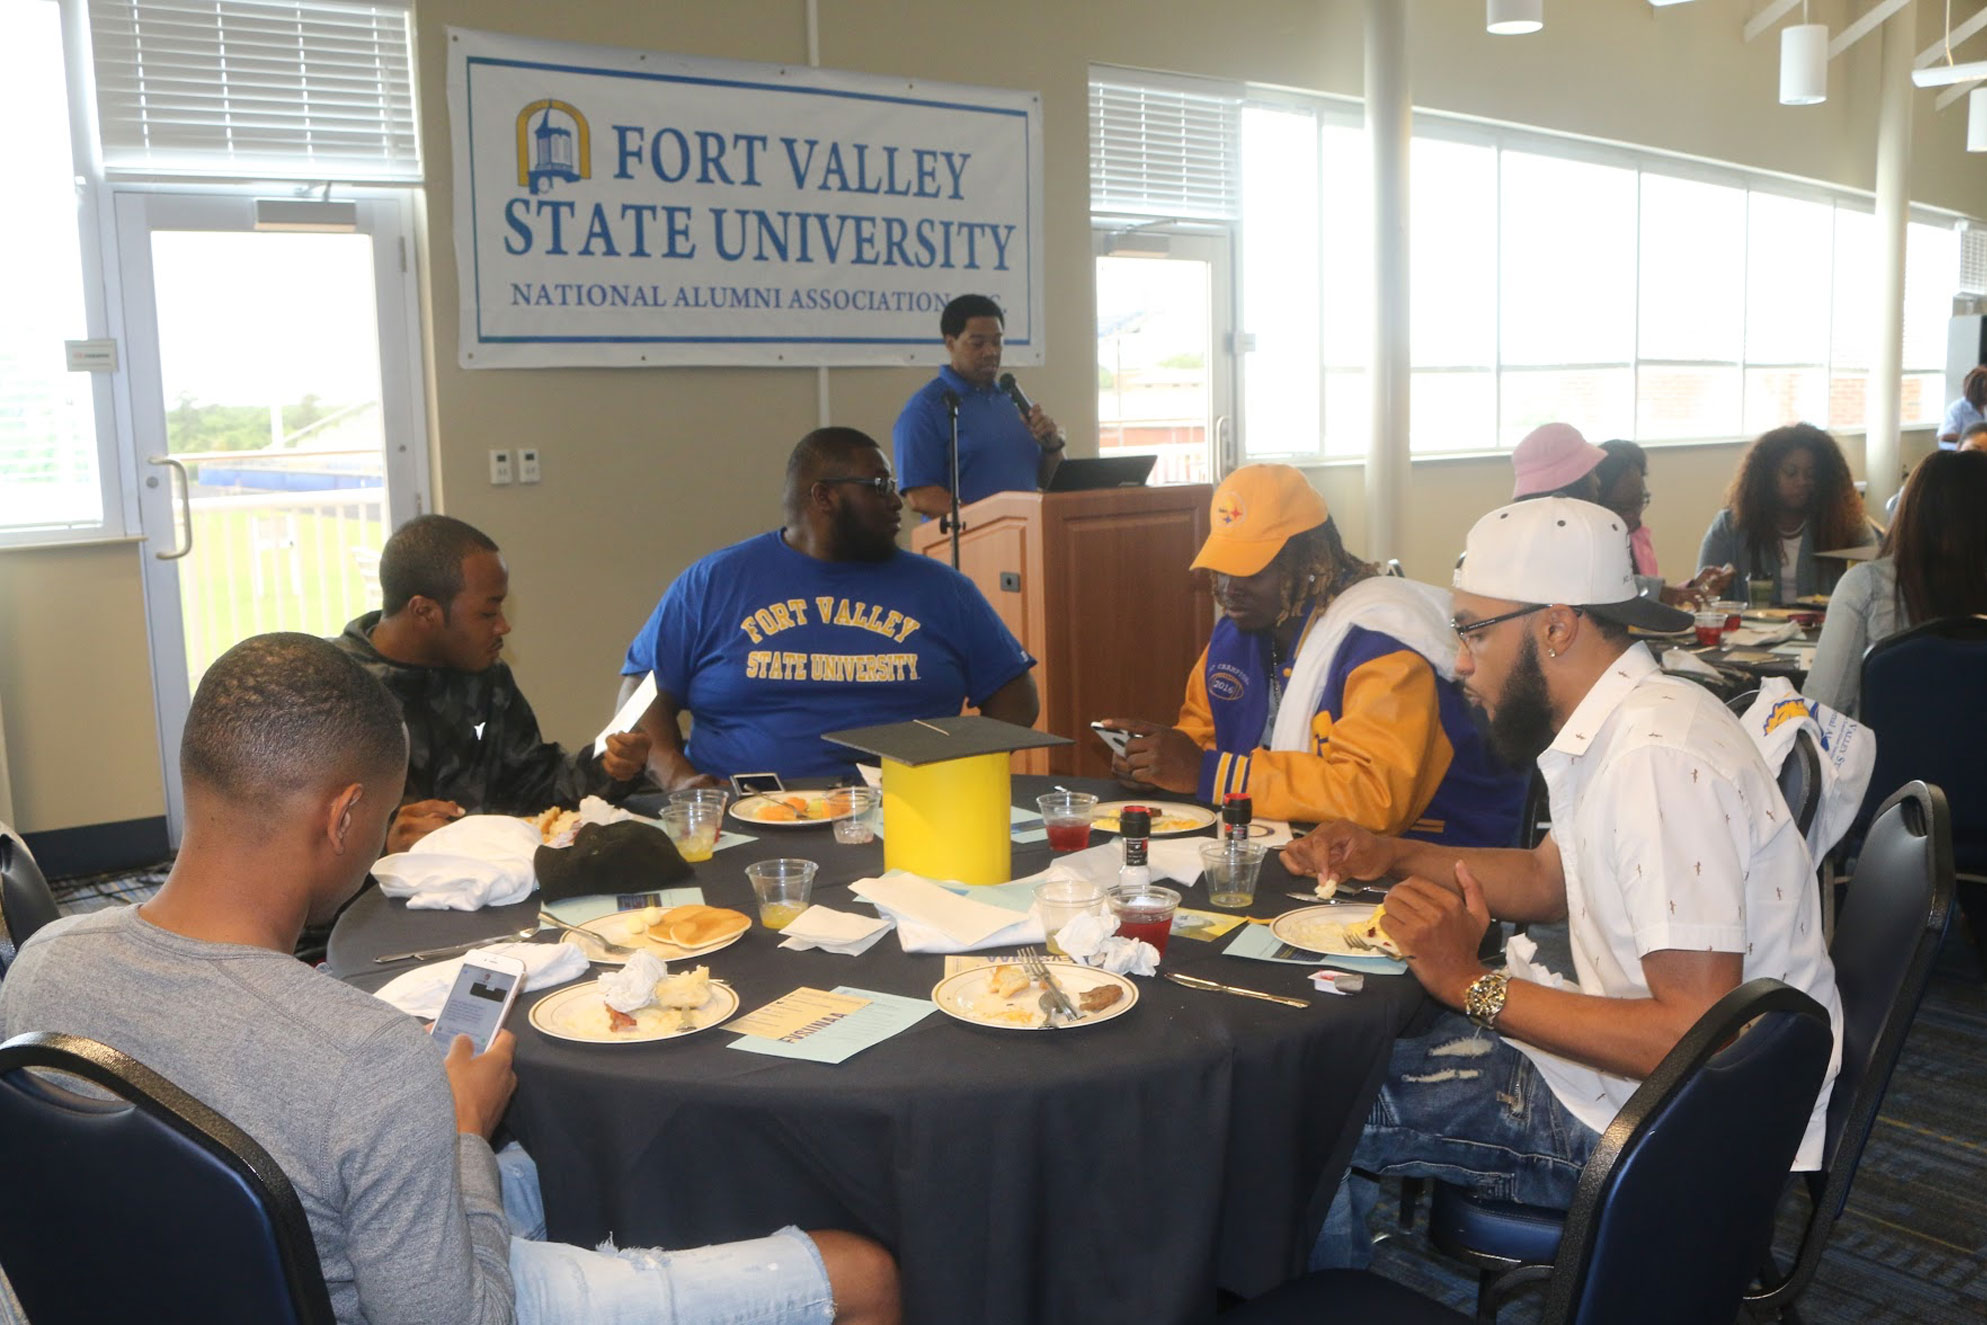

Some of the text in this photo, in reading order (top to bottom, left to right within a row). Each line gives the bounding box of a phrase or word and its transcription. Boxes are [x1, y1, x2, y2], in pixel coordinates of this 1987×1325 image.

[611, 123, 972, 201] FORT VALLEY
[503, 196, 1017, 272] STATE UNIVERSITY
[510, 282, 668, 308] NATIONAL
[672, 285, 782, 310] ALUMNI
[740, 596, 921, 644] FORT VALLEY
[746, 650, 918, 682] STATE UNIVERSITY
[1213, 680, 1233, 694] 2016
